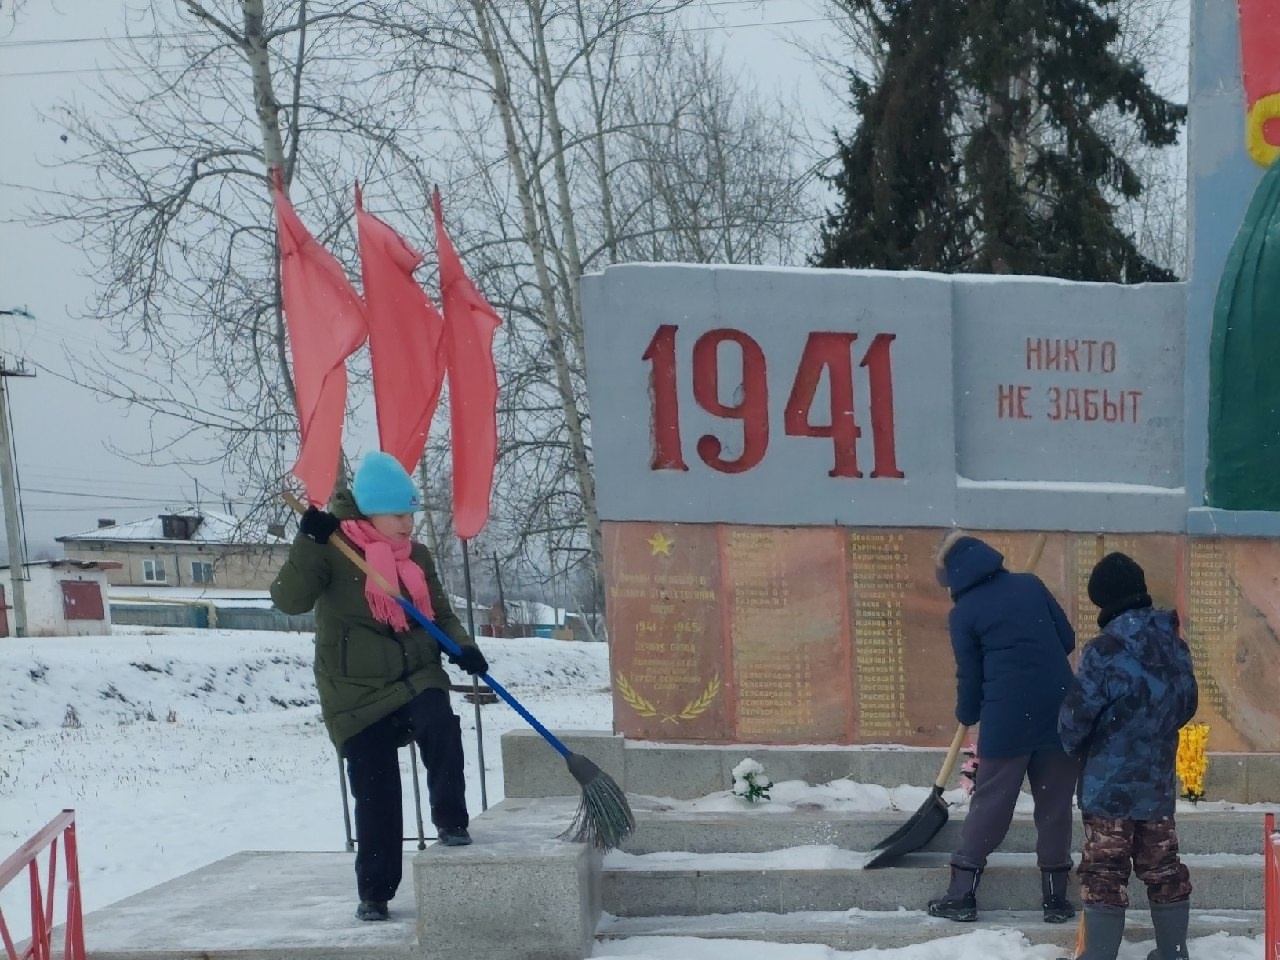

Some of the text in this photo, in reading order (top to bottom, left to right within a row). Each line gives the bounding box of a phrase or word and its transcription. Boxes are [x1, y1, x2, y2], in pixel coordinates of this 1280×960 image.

[1026, 337, 1116, 373] НИКТО
[642, 324, 905, 479] 1941
[997, 383, 1143, 424] НЕ ЗАБЫТ
